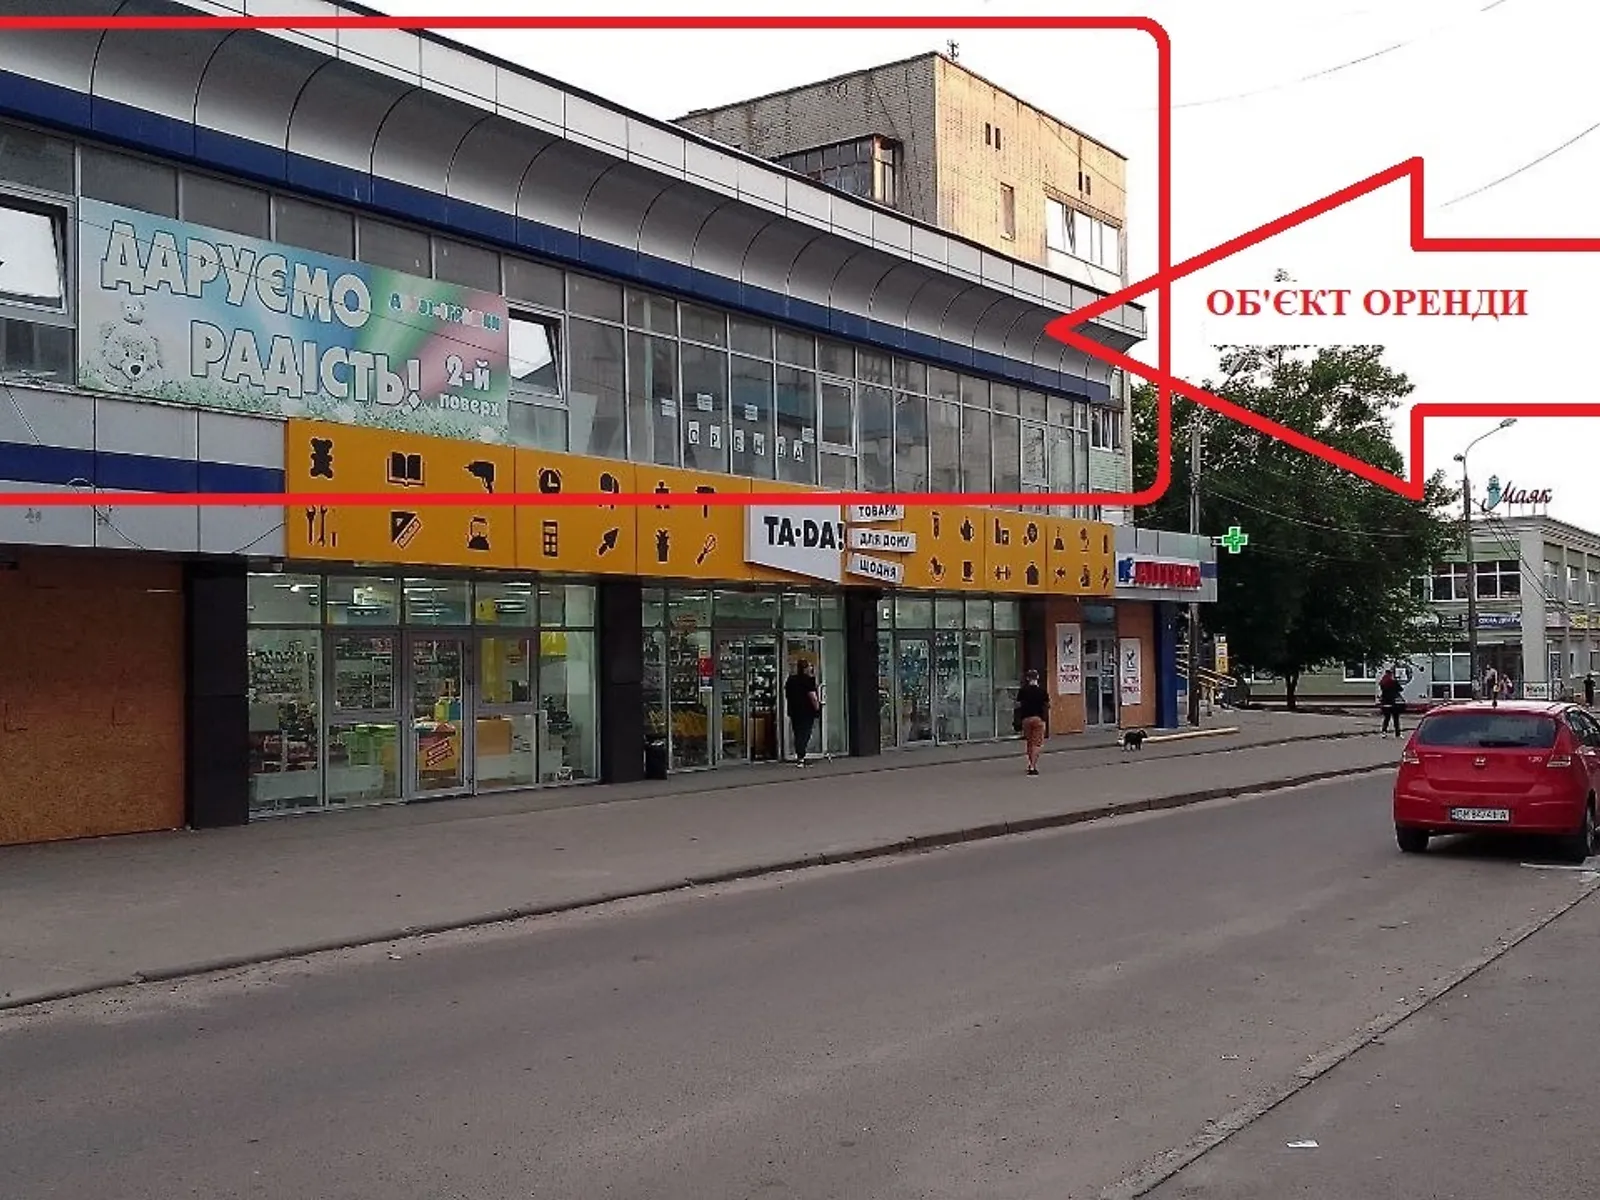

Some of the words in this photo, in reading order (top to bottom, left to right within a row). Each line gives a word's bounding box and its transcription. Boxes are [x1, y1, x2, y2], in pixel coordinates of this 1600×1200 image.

[100, 220, 372, 329] ДАРУЄМО
[190, 319, 422, 410] РАДІСТЬ!
[1496, 480, 1552, 504] Маяк
[858, 505, 898, 517] ТОВАРИ
[859, 533, 881, 546] ДЛЯ
[883, 534, 910, 548] ДОМУ
[859, 559, 897, 580] ЩОДНЯ
